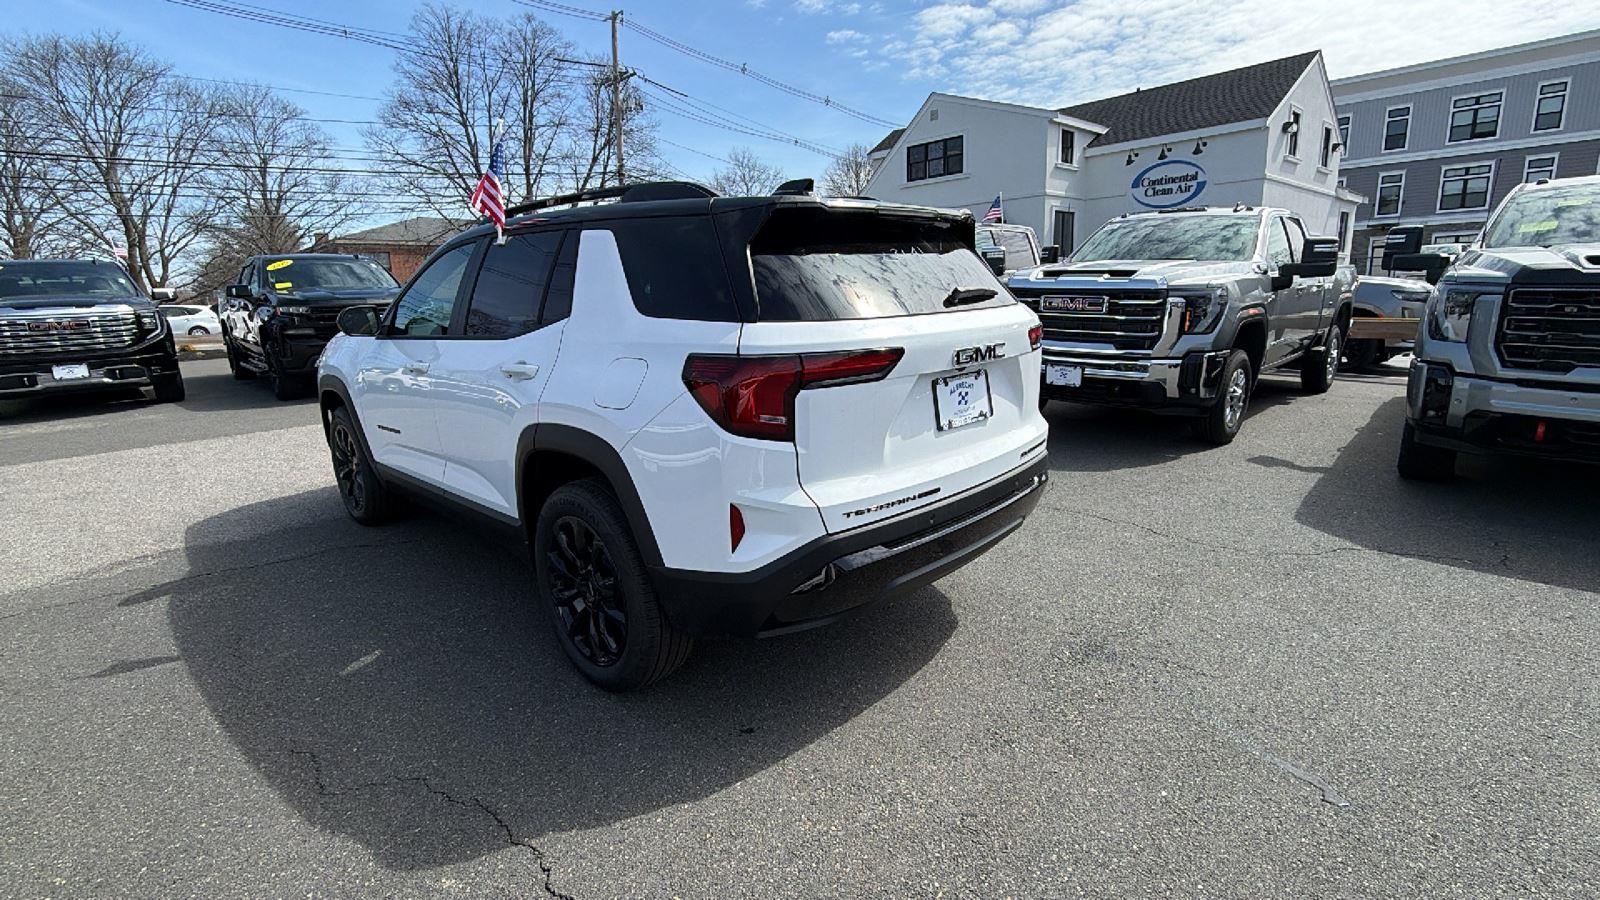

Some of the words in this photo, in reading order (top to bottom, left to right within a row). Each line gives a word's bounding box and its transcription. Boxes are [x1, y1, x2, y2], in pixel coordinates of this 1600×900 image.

[1141, 171, 1199, 187] Continental
[1144, 187, 1173, 198] Clean
[1175, 183, 1194, 194] Air
[1044, 298, 1103, 310] GMC
[29, 321, 88, 331] GMC
[952, 342, 1005, 366] GMC
[950, 382, 974, 396] ALBRECHT
[842, 495, 917, 518] TERRAIN
